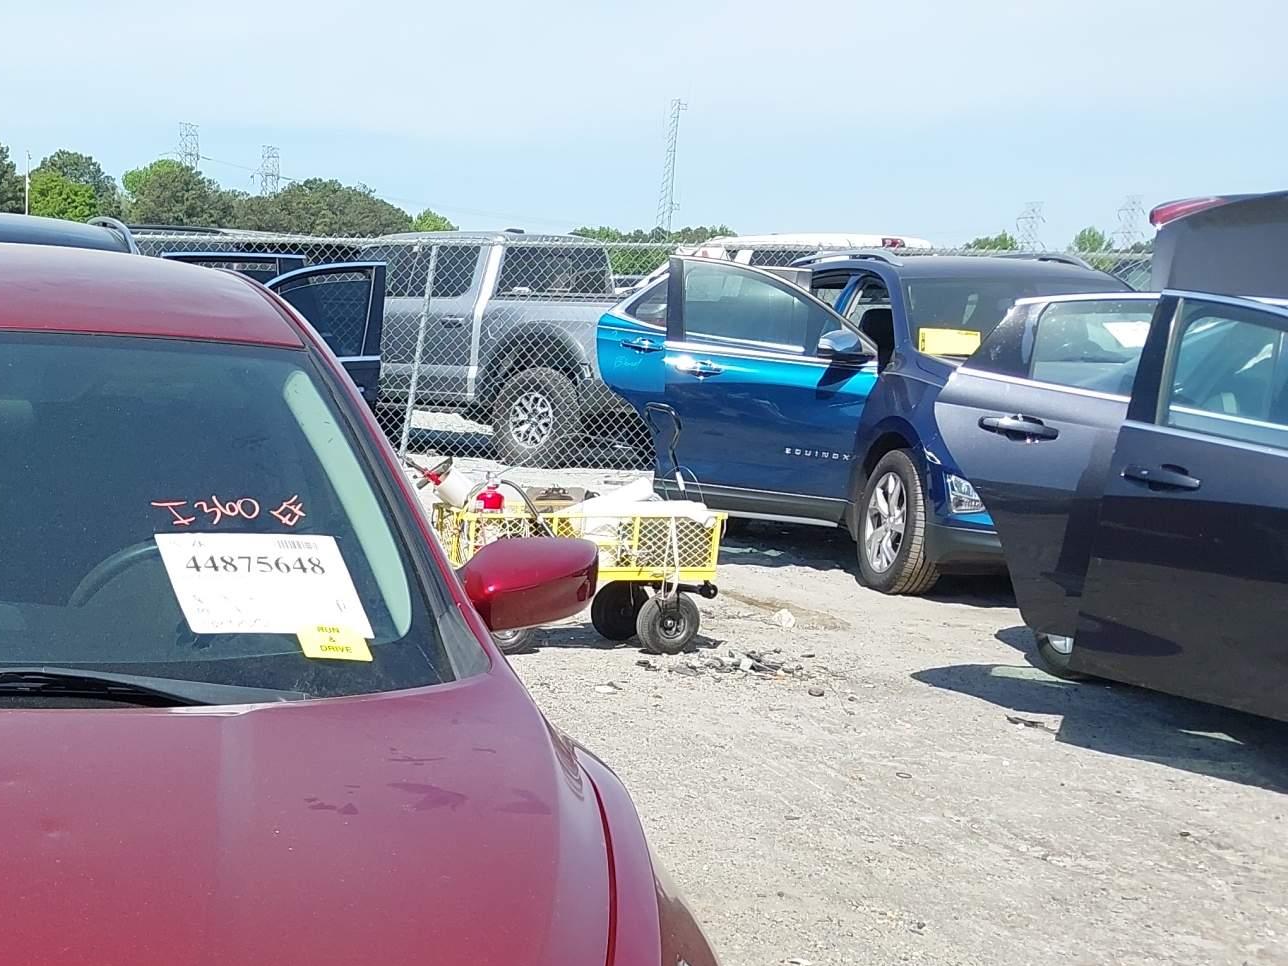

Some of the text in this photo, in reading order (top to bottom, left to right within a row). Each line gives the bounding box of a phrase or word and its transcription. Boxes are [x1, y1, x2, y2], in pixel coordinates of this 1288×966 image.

[784, 446, 851, 461] EQUINOX
[185, 555, 326, 576] 44875648
[316, 625, 341, 634] RUN
[319, 644, 353, 654] DRIVE
